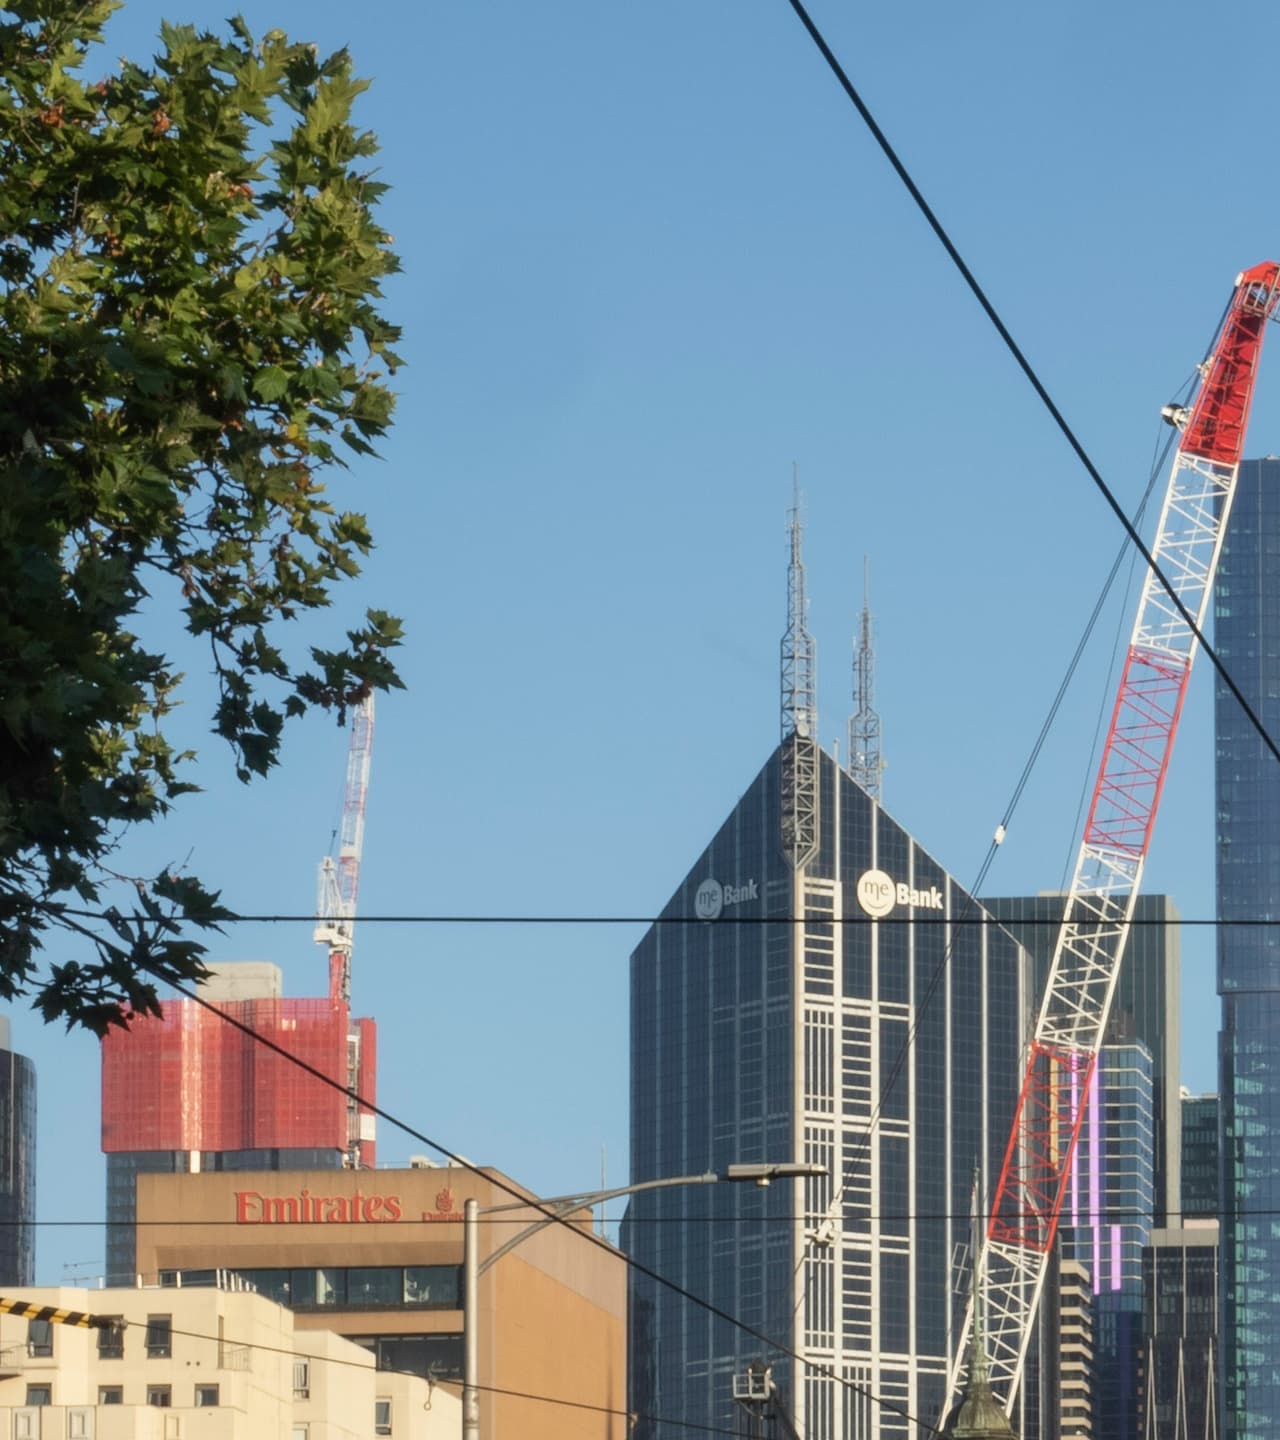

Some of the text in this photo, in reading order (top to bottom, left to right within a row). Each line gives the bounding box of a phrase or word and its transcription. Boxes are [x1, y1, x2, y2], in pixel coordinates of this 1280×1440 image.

[723, 879, 758, 906] Bank
[896, 883, 944, 909] Bank
[235, 1189, 402, 1224] Emirates
